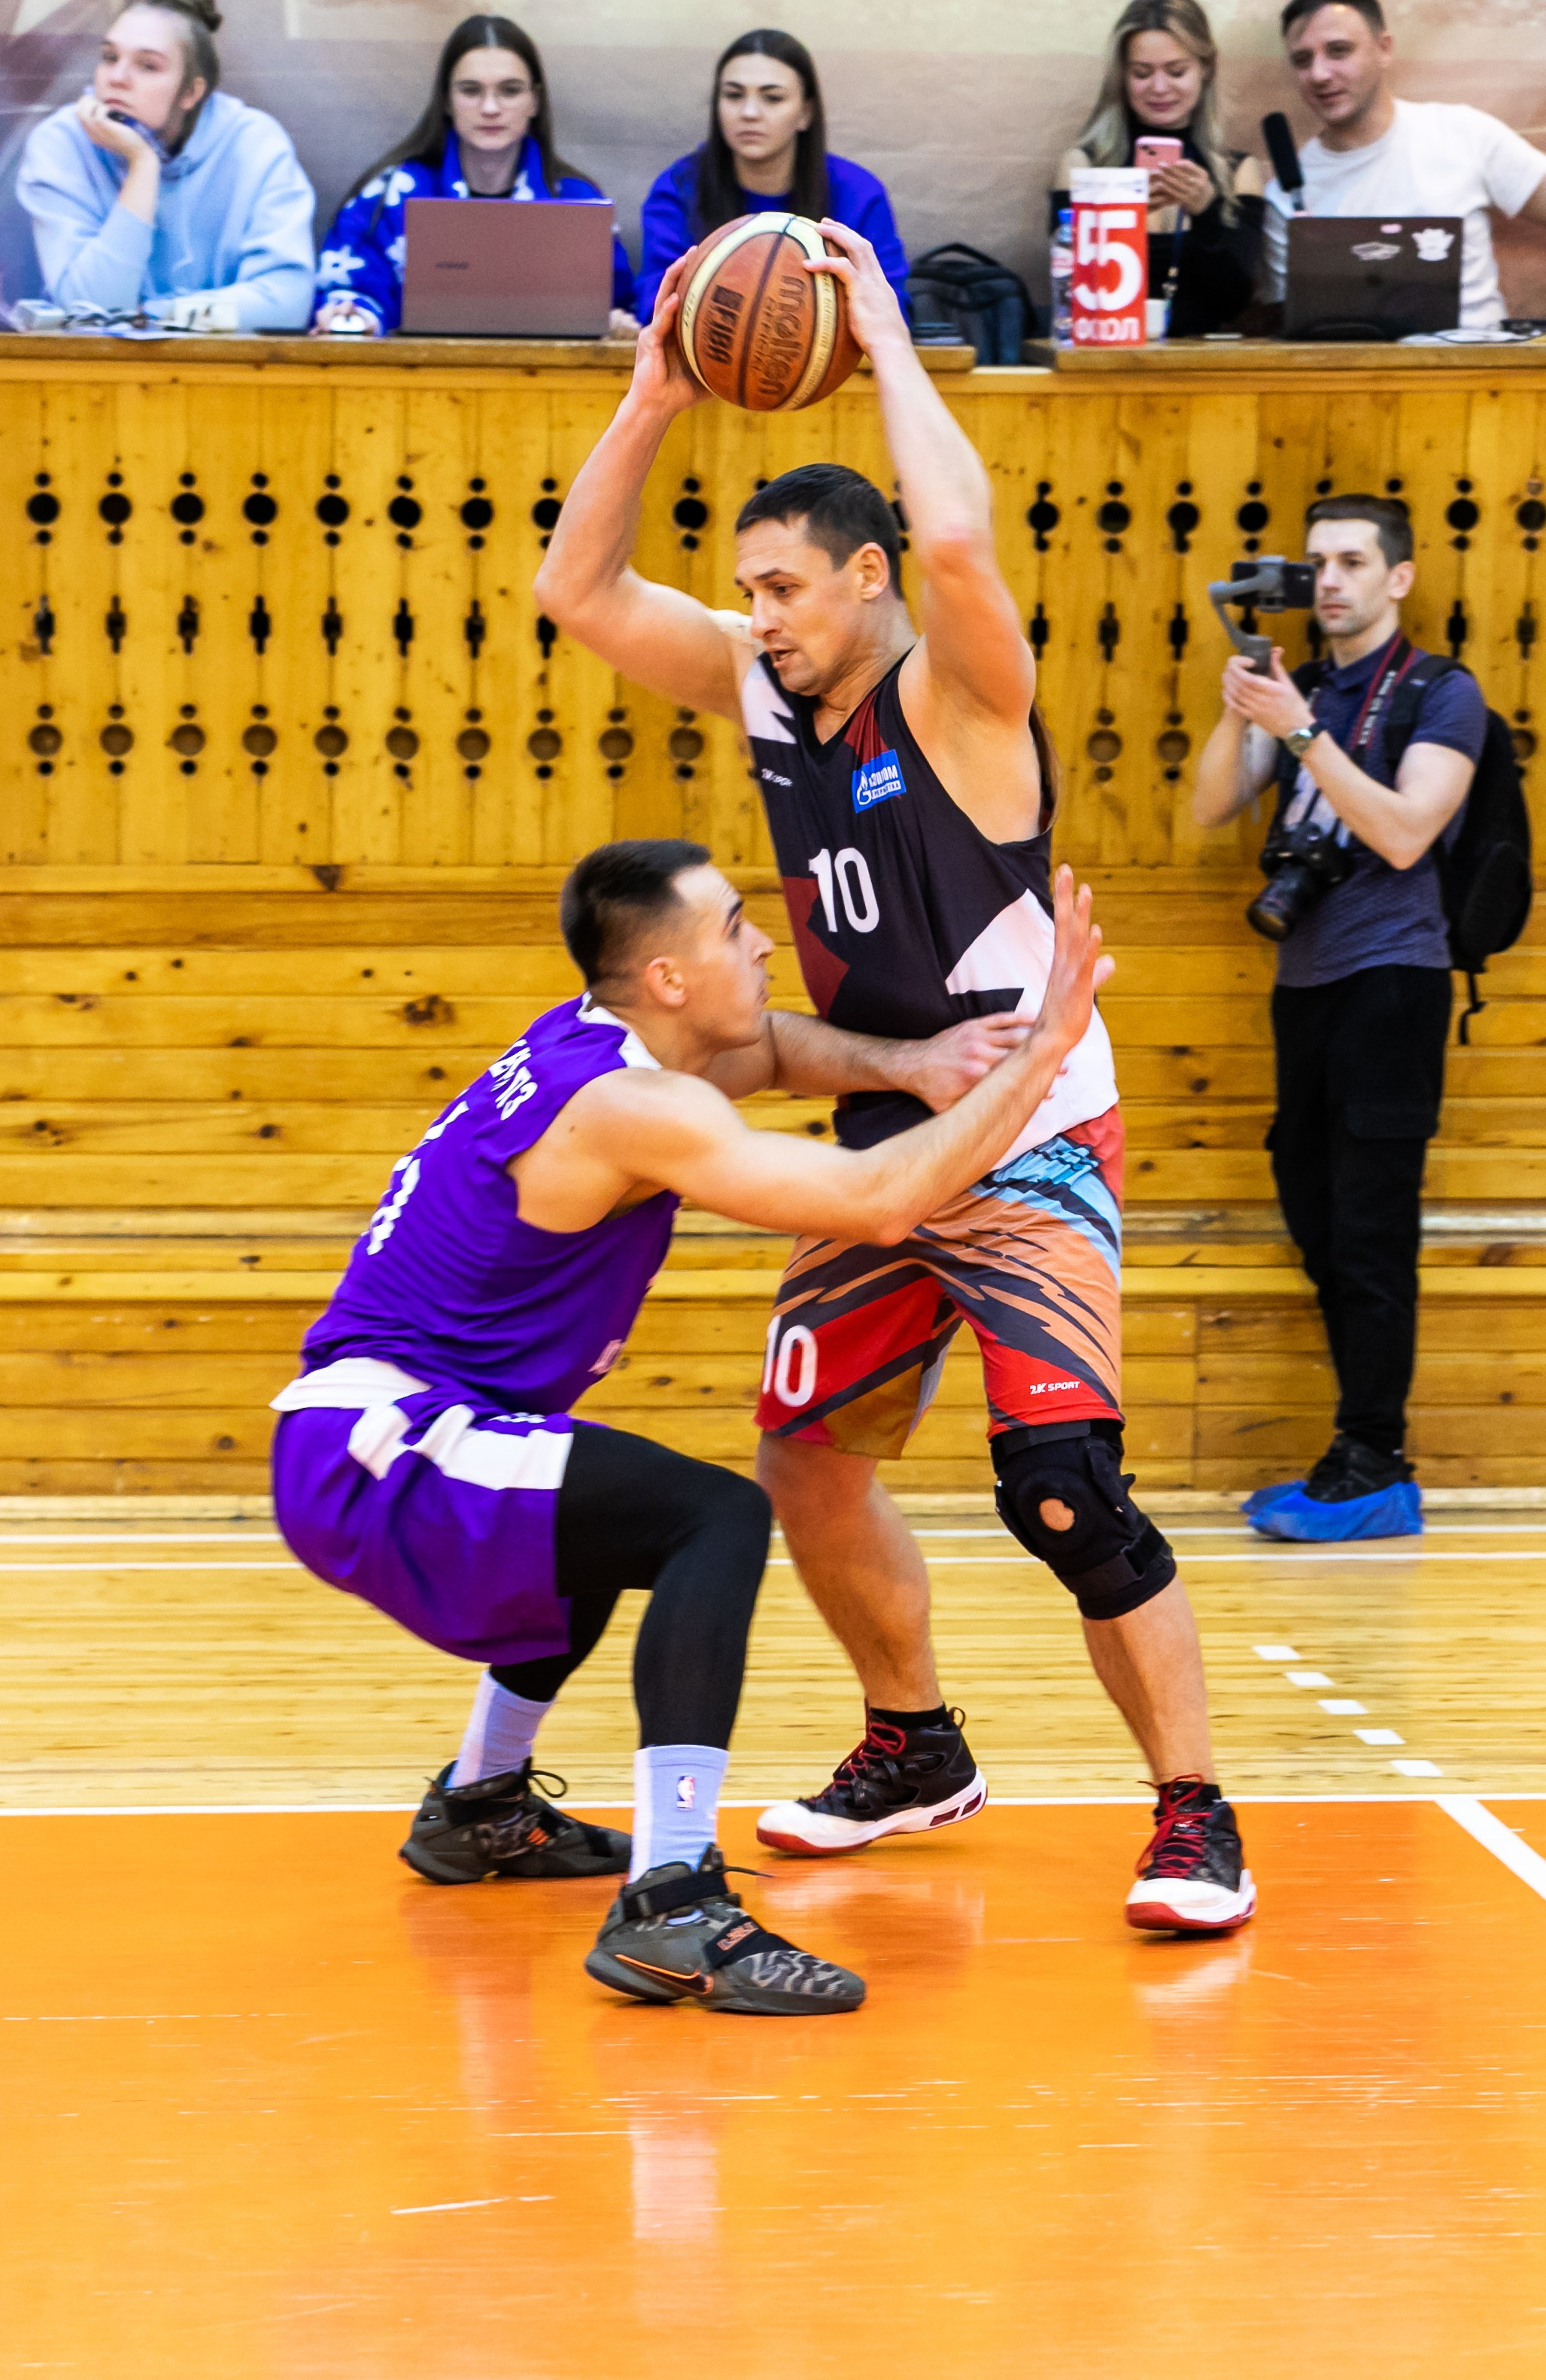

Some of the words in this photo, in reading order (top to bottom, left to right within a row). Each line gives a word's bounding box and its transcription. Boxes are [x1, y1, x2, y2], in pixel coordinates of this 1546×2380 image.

[808, 847, 879, 933] 10
[762, 1315, 818, 1407] 10
[1047, 1381, 1080, 1392] SPORT
